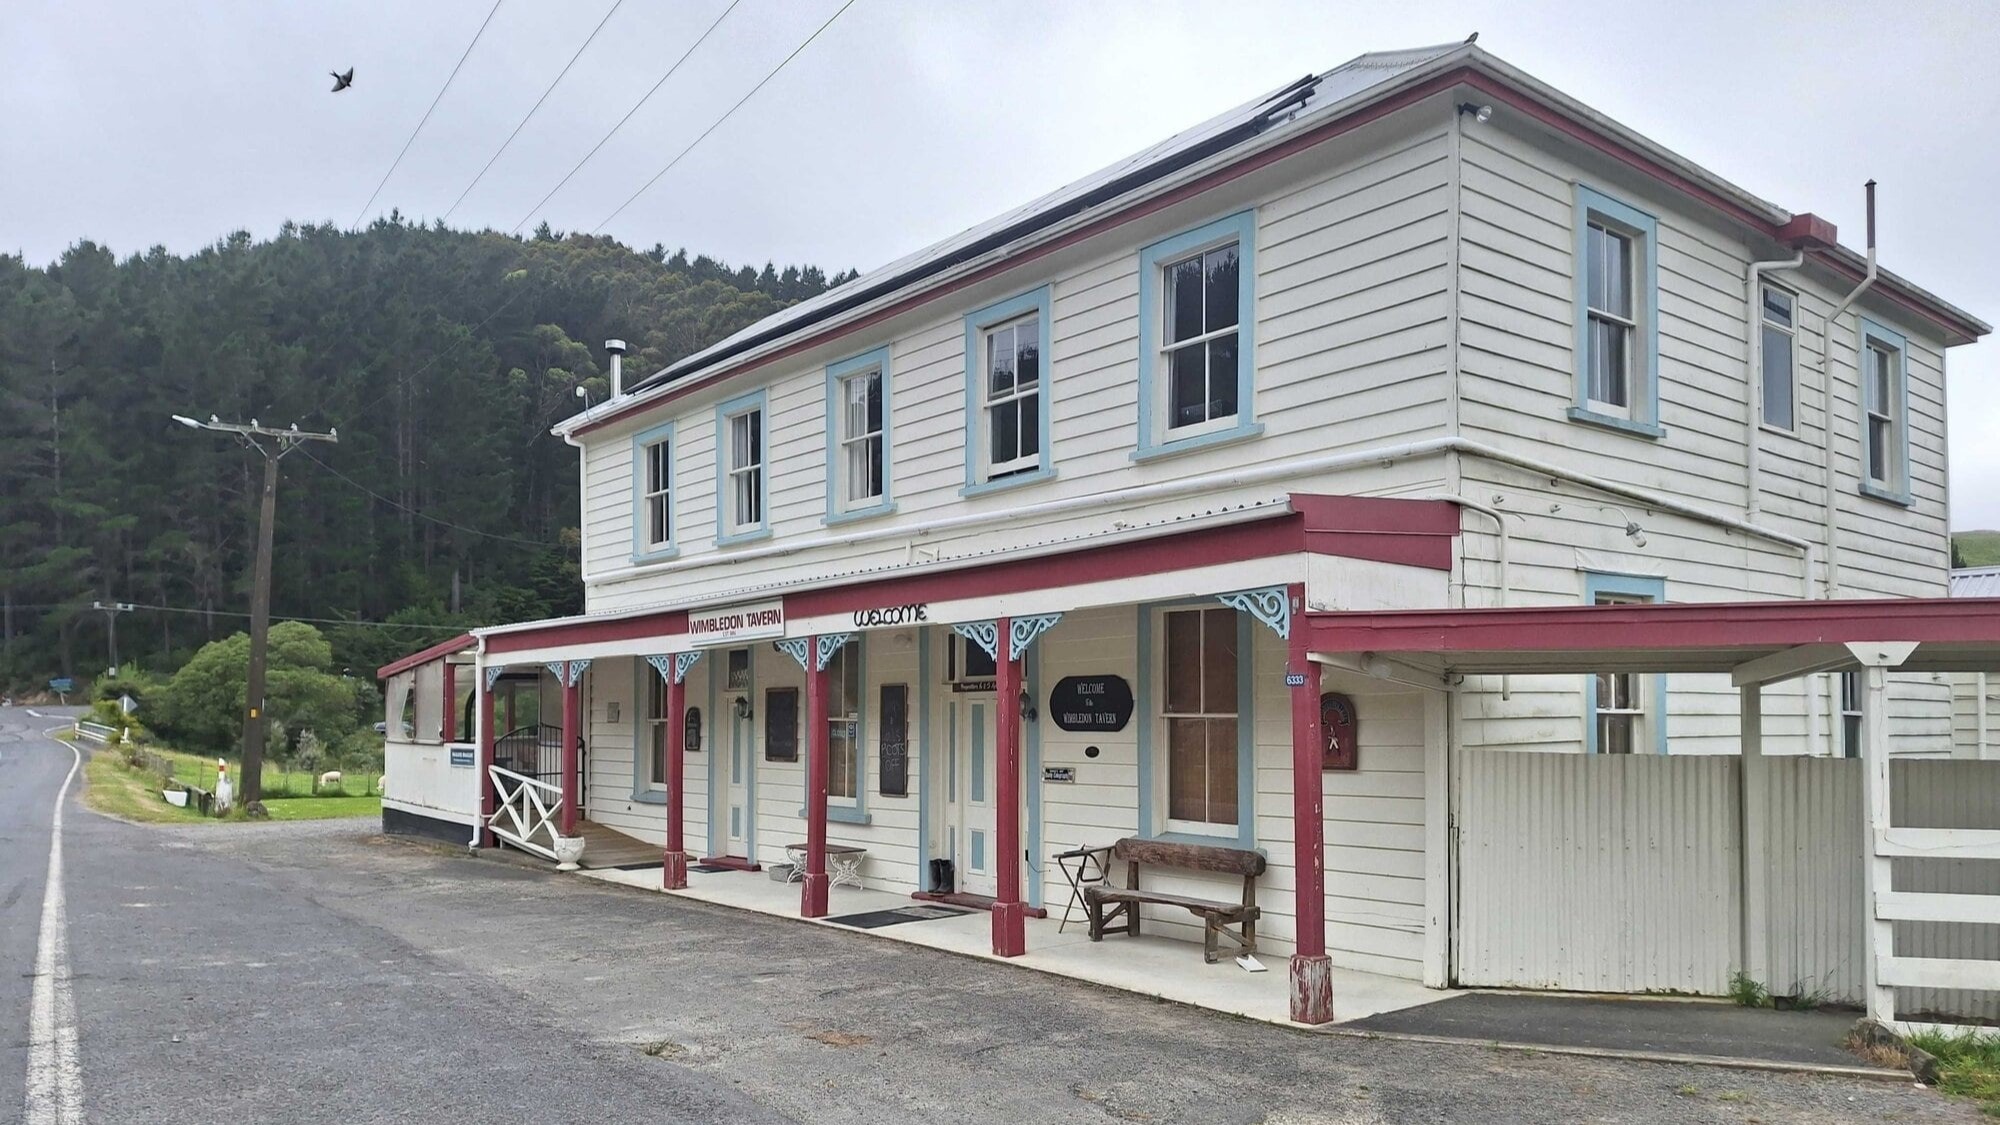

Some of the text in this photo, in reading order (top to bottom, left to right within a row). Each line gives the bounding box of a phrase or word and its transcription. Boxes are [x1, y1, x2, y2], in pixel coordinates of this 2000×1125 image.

[690, 608, 781, 635] WIMBLEDON TAVERN
[1286, 675, 1303, 685] 6333
[1077, 682, 1105, 695] WELCOME
[1063, 712, 1117, 724] WIMBLEDON TAVERN
